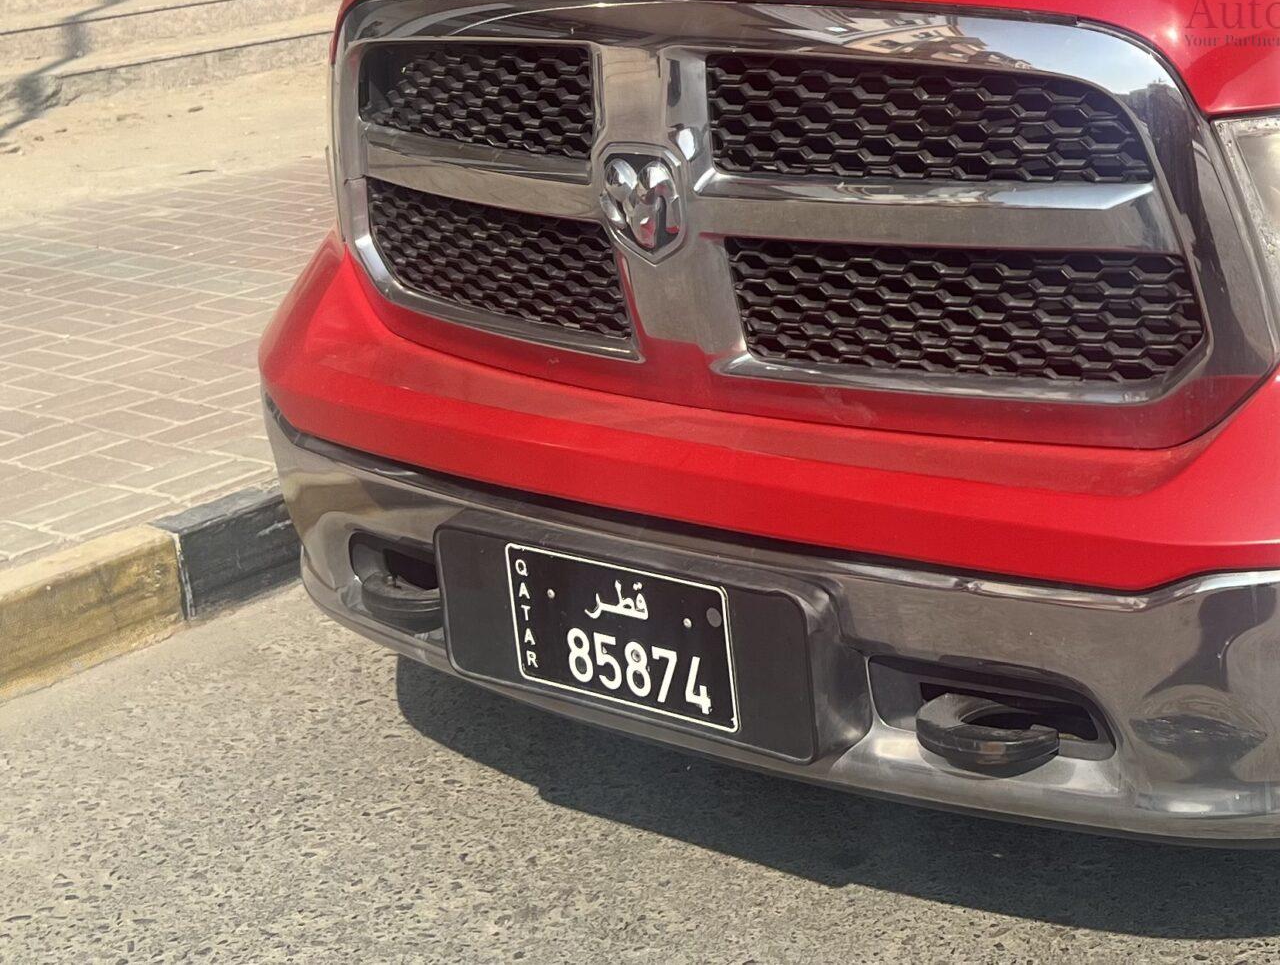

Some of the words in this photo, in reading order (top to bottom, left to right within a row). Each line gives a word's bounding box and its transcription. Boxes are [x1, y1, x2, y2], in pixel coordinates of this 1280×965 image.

[514, 558, 539, 669] QATAR
[584, 580, 649, 620] قطر
[566, 627, 713, 716] 85874
